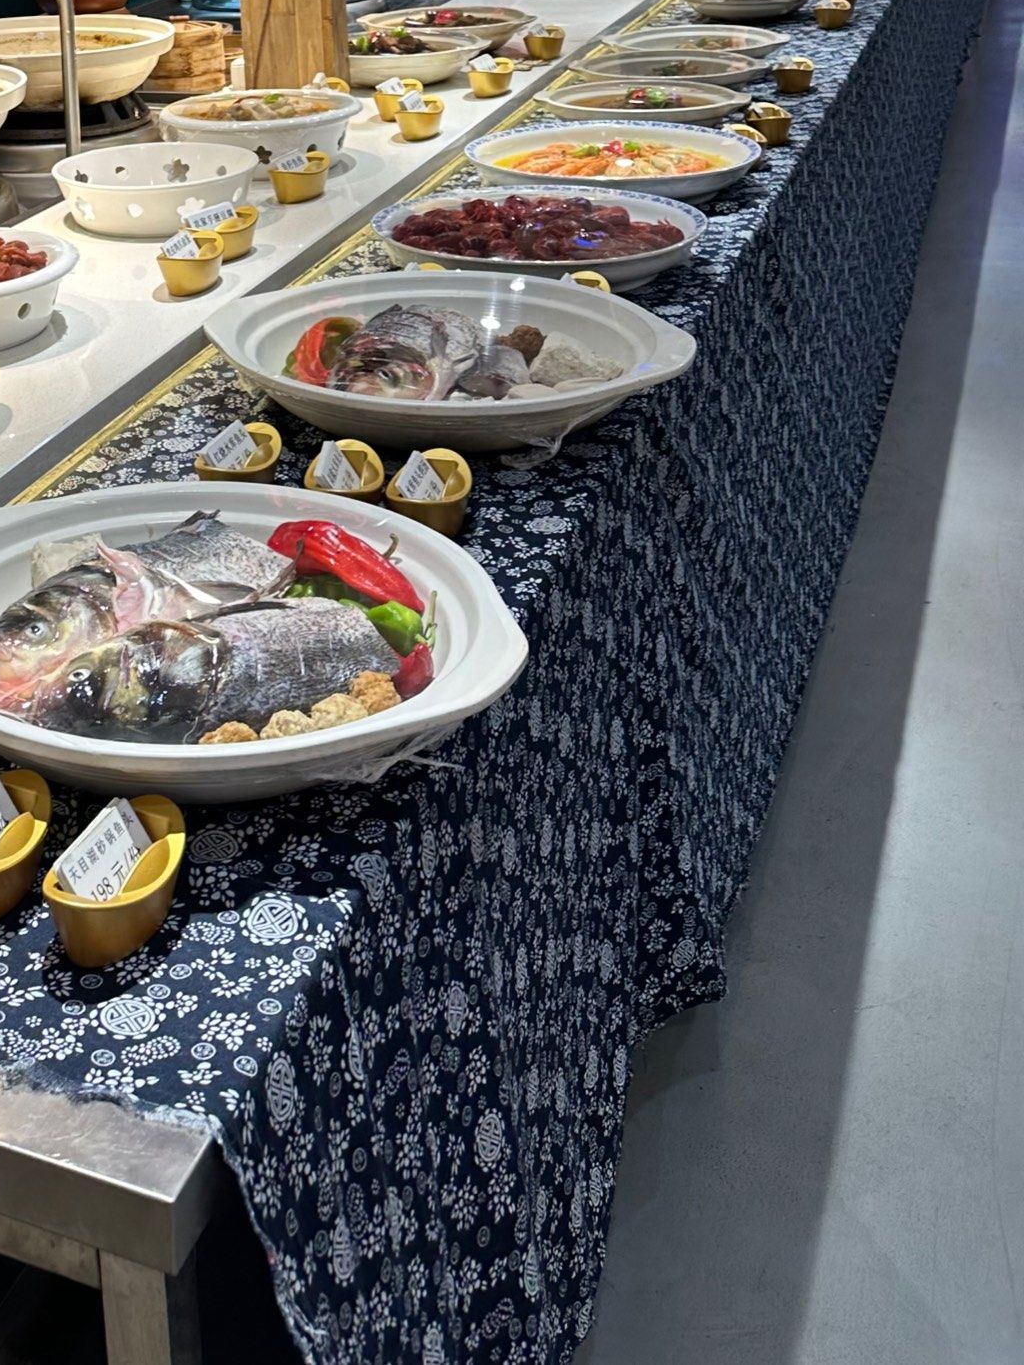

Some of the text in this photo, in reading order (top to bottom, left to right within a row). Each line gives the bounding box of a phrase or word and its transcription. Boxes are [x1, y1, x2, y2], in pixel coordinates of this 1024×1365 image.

[68, 810, 134, 885] 天目湖砂锅鱼头
[90, 876, 115, 902] 198
